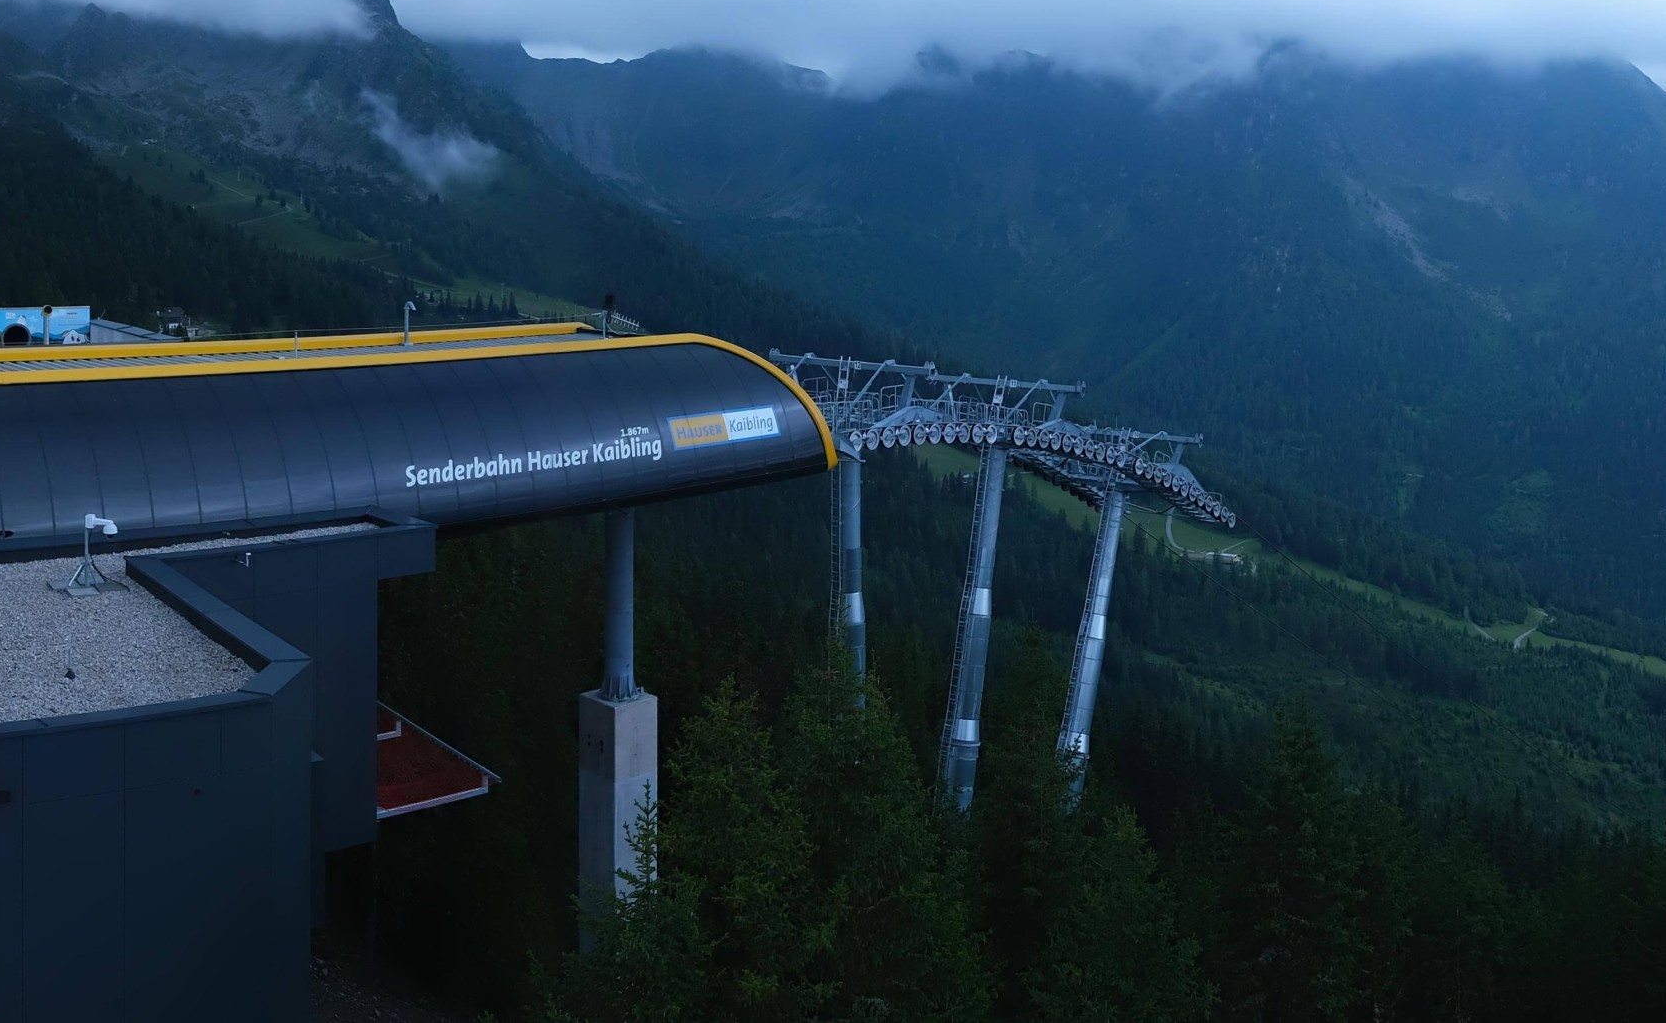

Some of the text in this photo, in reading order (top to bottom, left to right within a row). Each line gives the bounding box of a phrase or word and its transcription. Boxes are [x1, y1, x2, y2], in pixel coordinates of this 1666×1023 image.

[620, 426, 649, 437] 1.867m
[676, 416, 774, 440] HAUSER Kaibling
[405, 438, 662, 487] Senderbahn Hauser Kaibling
